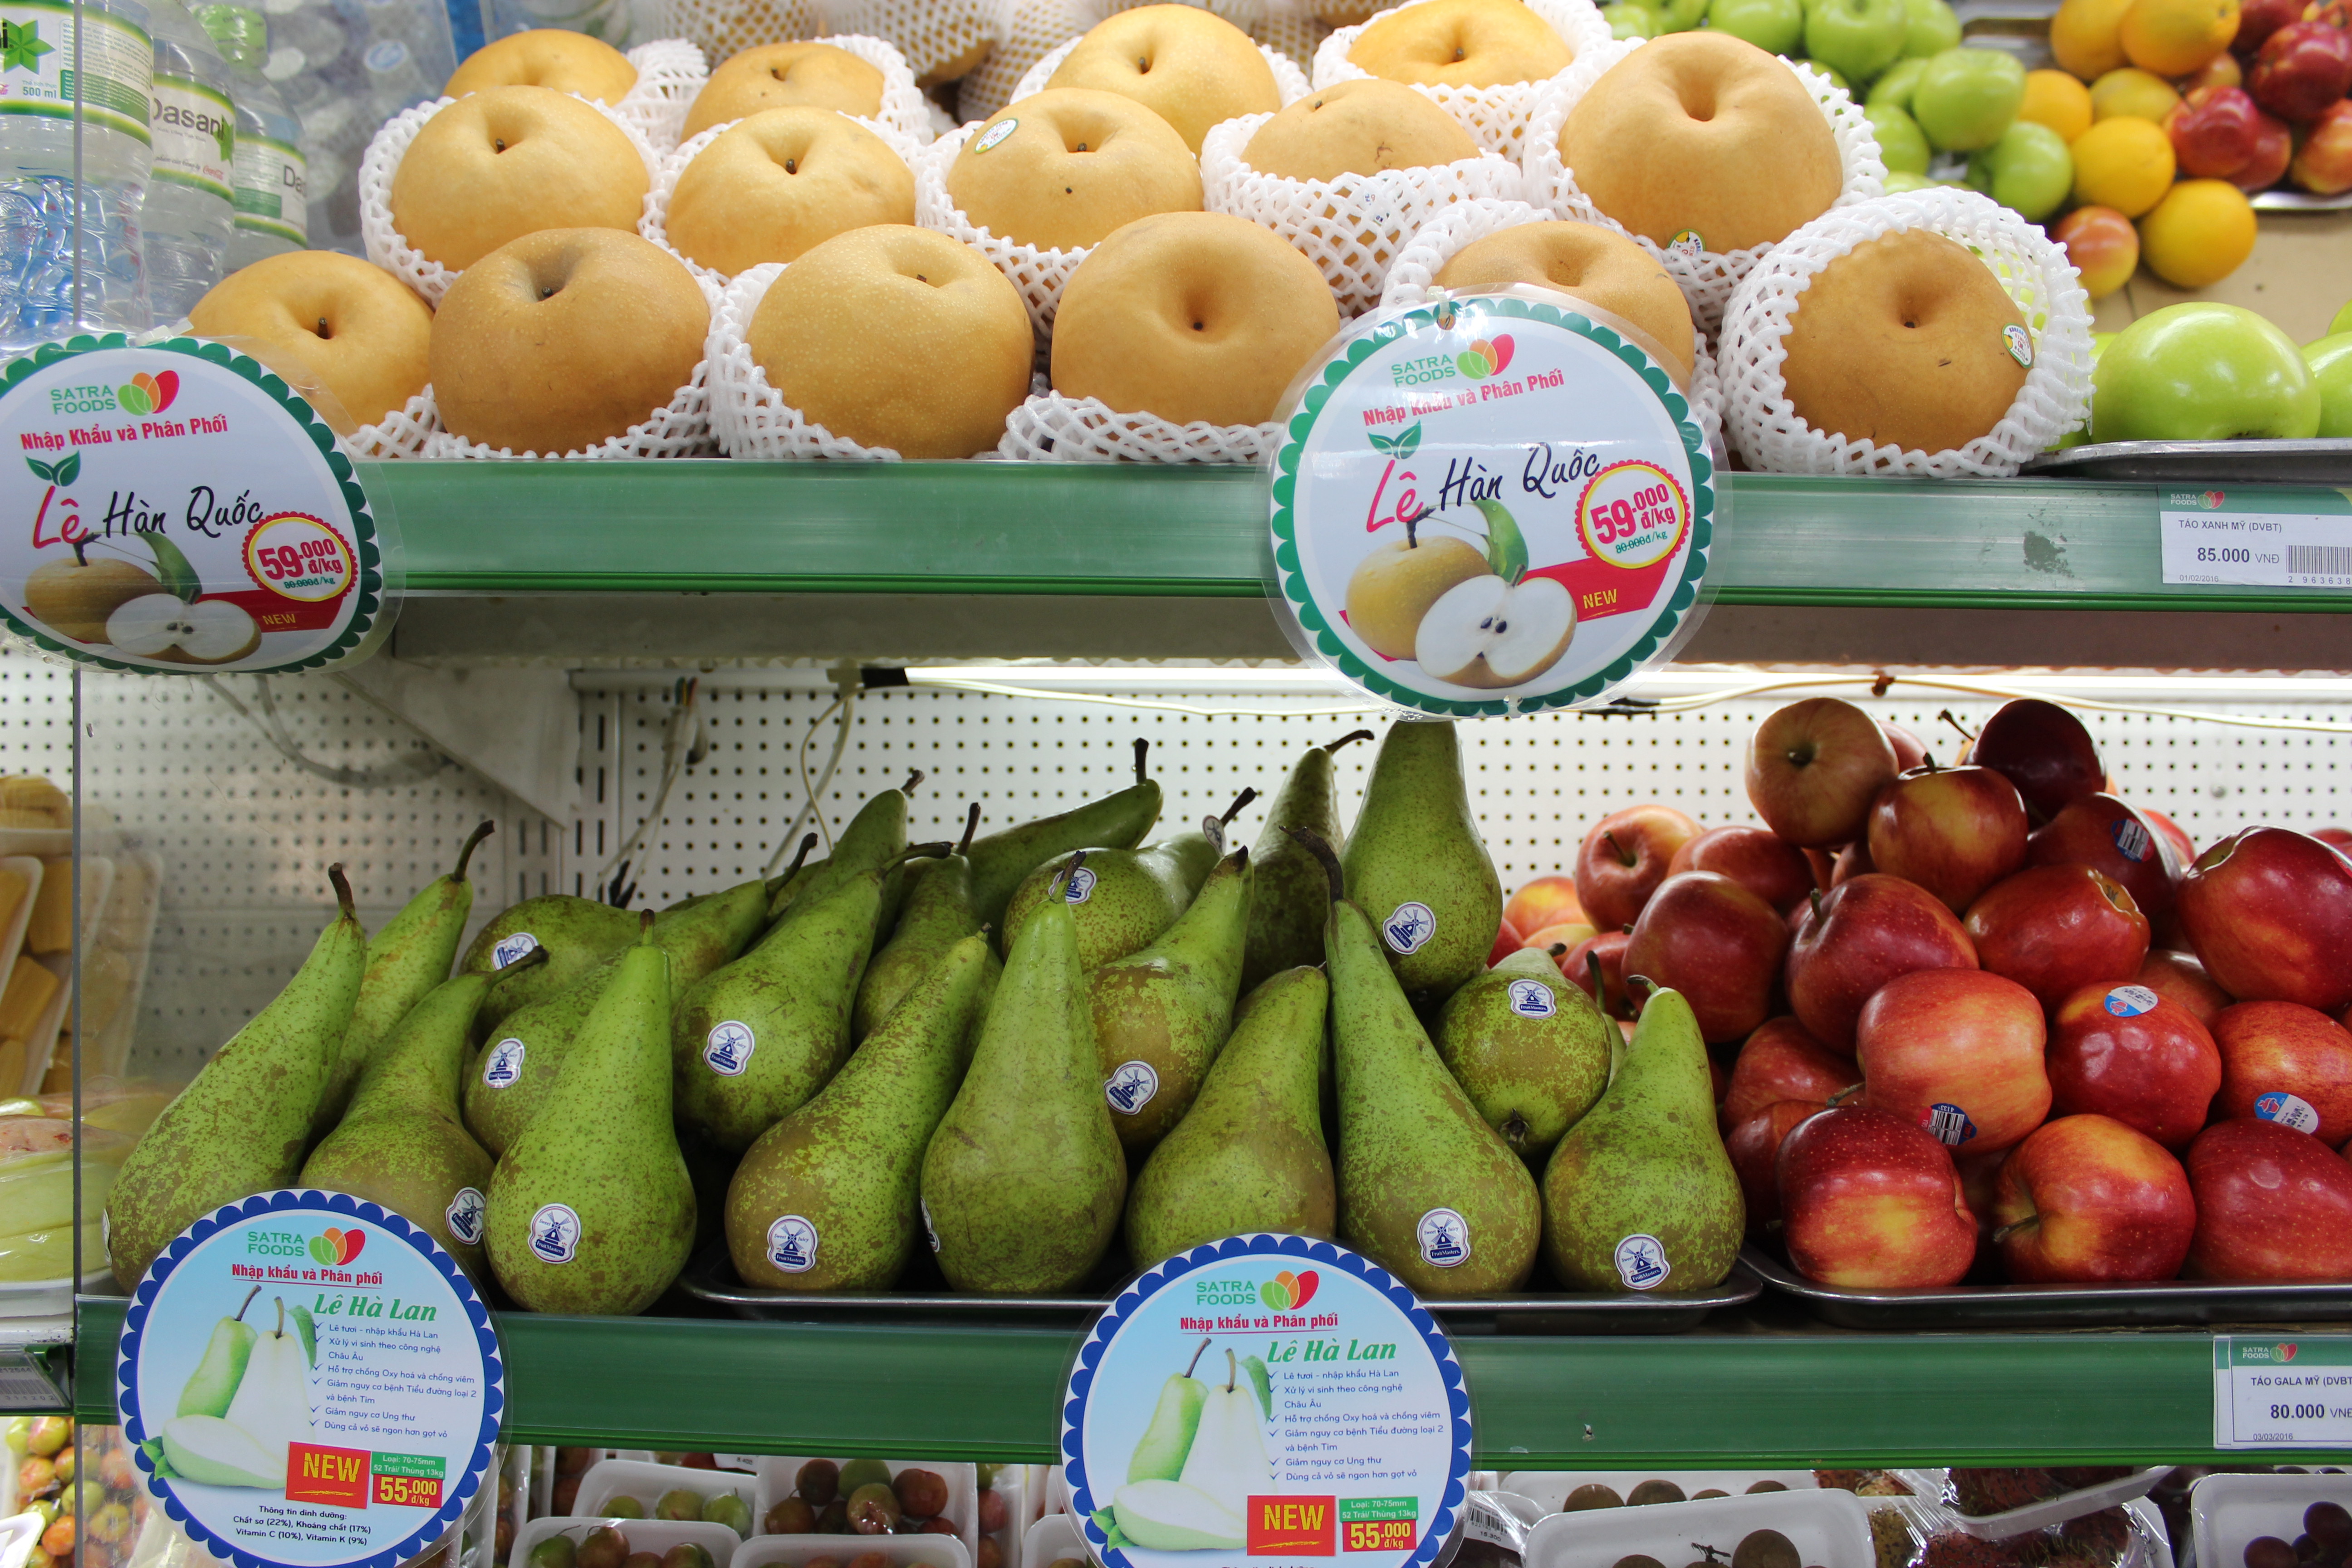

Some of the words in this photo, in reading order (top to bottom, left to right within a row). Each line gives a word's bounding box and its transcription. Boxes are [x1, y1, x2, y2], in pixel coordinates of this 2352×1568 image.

[23, 86, 41, 97] 500
[44, 89, 57, 99] ml
[1391, 354, 1453, 375] SATRA
[1394, 366, 1456, 388] FOODS
[50, 384, 114, 401] SATRA
[1362, 406, 1406, 426] Nhập
[1456, 389, 1477, 406] và
[1480, 380, 1524, 401] Phân
[1526, 368, 1565, 391] Phối
[52, 398, 117, 415] FOODS
[21, 432, 65, 451] Nhập
[69, 425, 113, 445] Khẩu
[116, 425, 137, 441] và
[142, 421, 185, 439] Phân
[190, 414, 228, 434] Phối
[1366, 460, 1425, 533] Lê
[1439, 456, 1503, 512] Hàn
[1522, 441, 1601, 499] Quốc
[33, 485, 88, 549] Lê
[103, 491, 167, 539] Hàn
[186, 485, 264, 539] Quốc
[1641, 507, 1676, 529] đ/kg
[2178, 518, 2199, 529] TÁO
[2201, 521, 2228, 529] XANH
[2231, 520, 2246, 530] MỸ
[2249, 522, 2282, 534] (DVBT)
[2197, 547, 2250, 563] 85.000
[2254, 553, 2279, 564] VNĐ
[308, 559, 343, 574] đ/kg
[2179, 574, 2220, 583] 01/02/2016
[1583, 588, 1618, 610] NEW
[262, 614, 296, 625] NEW
[248, 1231, 304, 1245] SATRA
[247, 1243, 305, 1257] FOODS
[232, 1264, 264, 1279] Nhập
[268, 1264, 298, 1279] khẩu
[302, 1269, 317, 1280] và
[321, 1269, 352, 1283] Phân
[356, 1271, 382, 1286] phối
[1196, 1280, 1255, 1293] SATRA
[1196, 1293, 1256, 1305] FOODS
[314, 1294, 343, 1315] Lê
[348, 1296, 383, 1318] Hà
[389, 1299, 436, 1322] Lan
[1181, 1317, 1213, 1332] Nhập
[1218, 1313, 1250, 1329] khẩu
[1254, 1316, 1269, 1328] và
[1274, 1315, 1306, 1328] Phân
[1311, 1313, 1338, 1329] phối
[1267, 1340, 1298, 1363] Lê
[1303, 1339, 1340, 1362] Hà
[1347, 1339, 1396, 1361] Lan
[1323, 1371, 1344, 1380] nhập
[1346, 1368, 1366, 1378] khẩu
[2250, 1375, 2271, 1386] TÁO
[2274, 1377, 2302, 1386] GALA
[2305, 1375, 2320, 1385] MỸ
[2323, 1376, 2352, 1387] (DVBT
[1284, 1385, 1296, 1394] Xử
[1298, 1386, 1305, 1395] lý
[1358, 1384, 1379, 1393] công
[1382, 1383, 1403, 1393] nghệ
[1309, 1398, 1322, 1408] Âu
[2270, 1403, 2324, 1419] 80.000
[1285, 1414, 1297, 1423] Hỗ
[1314, 1413, 1340, 1423] chống
[1343, 1413, 1359, 1422] Oxy
[1380, 1412, 1389, 1421] và
[1392, 1411, 1418, 1421] chống
[1285, 1429, 1308, 1437] Giảm
[1310, 1430, 1331, 1438] nguy
[1346, 1428, 1367, 1436] bệnh
[1369, 1426, 1388, 1435] Tiểu
[1391, 1426, 1418, 1435] đường
[1421, 1426, 1435, 1434] loại
[1437, 1425, 1444, 1433] 2
[1297, 1443, 1318, 1452] bệnh
[303, 1452, 361, 1483] NEW
[1286, 1457, 1308, 1466] Giảm
[1311, 1459, 1331, 1467] nguy
[1347, 1457, 1365, 1466] Ung
[1286, 1472, 1309, 1482] Dùng
[1311, 1472, 1322, 1480] cả
[1324, 1471, 1334, 1480] vỏ
[1391, 1470, 1405, 1480] gọt
[411, 1495, 430, 1506] đ/kg
[1351, 1500, 1370, 1509] Loại:
[1372, 1499, 1407, 1508] 70-75mm
[259, 1505, 284, 1516] Thông
[300, 1509, 317, 1517] dinh
[319, 1511, 347, 1521] dưỡng:
[1264, 1504, 1325, 1530] NEW
[1353, 1510, 1370, 1519] Trái/
[1372, 1510, 1396, 1519] Thùng
[1398, 1509, 1416, 1518] 13kg
[233, 1515, 253, 1524] Chất
[267, 1518, 294, 1528] (22%),
[296, 1520, 327, 1531] Khoáng
[329, 1523, 347, 1532] chất
[349, 1524, 371, 1534] (17%)
[236, 1528, 266, 1537] Vitamin
[278, 1531, 303, 1541] (10%),
[306, 1533, 337, 1542] Vitamin
[348, 1536, 367, 1546] (9%)
[1384, 1539, 1404, 1549] đ/kg
